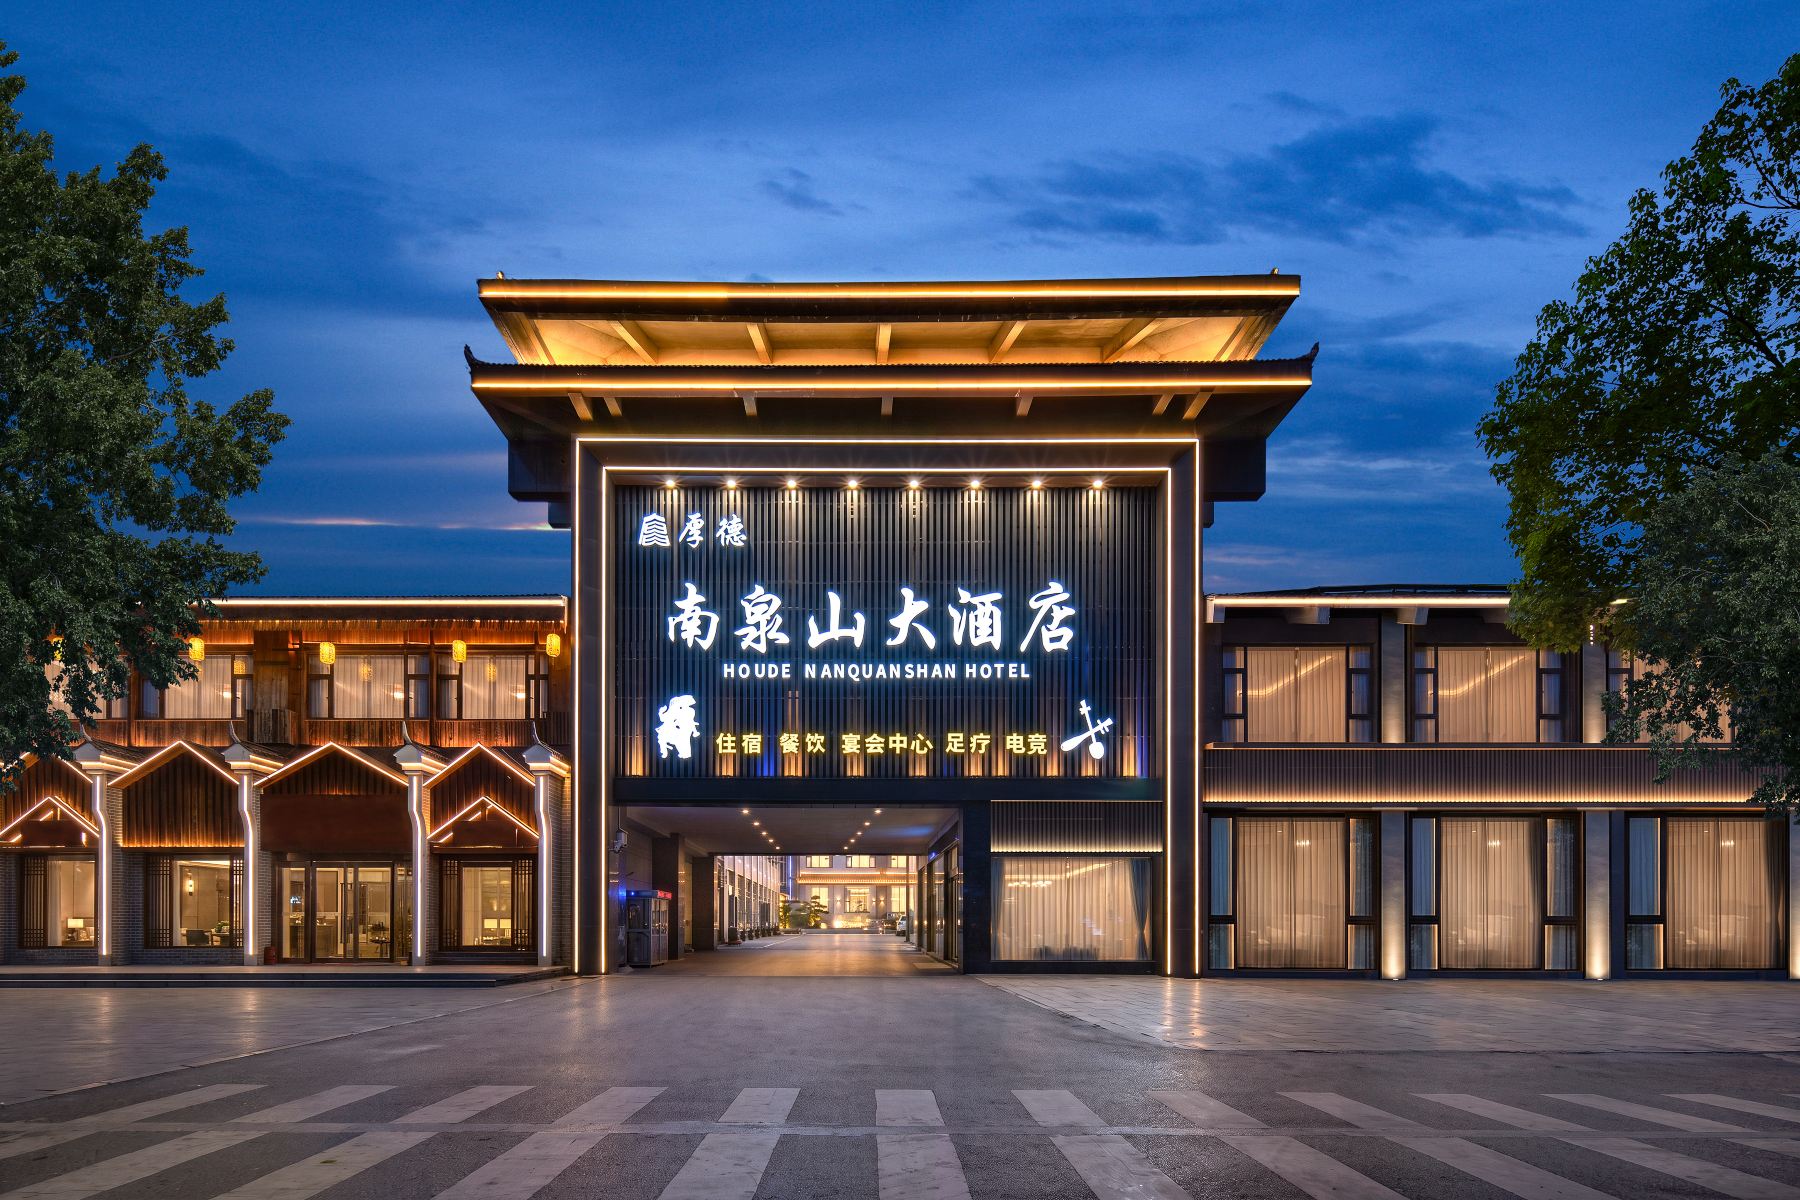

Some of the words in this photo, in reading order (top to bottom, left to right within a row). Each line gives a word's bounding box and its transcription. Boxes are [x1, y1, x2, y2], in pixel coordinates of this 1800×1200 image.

[678, 512, 747, 548] 厚德
[667, 582, 1076, 653] 南泉山大酒店
[723, 663, 791, 679] HOUDE
[804, 663, 956, 682] NANQUANSHAN
[965, 663, 1030, 679] HOTEL
[715, 733, 763, 755] 住宿
[779, 733, 826, 755] 餐饮
[841, 733, 934, 755] 宴会中心
[945, 733, 991, 755] 足疗
[1005, 733, 1048, 755] 电竞
